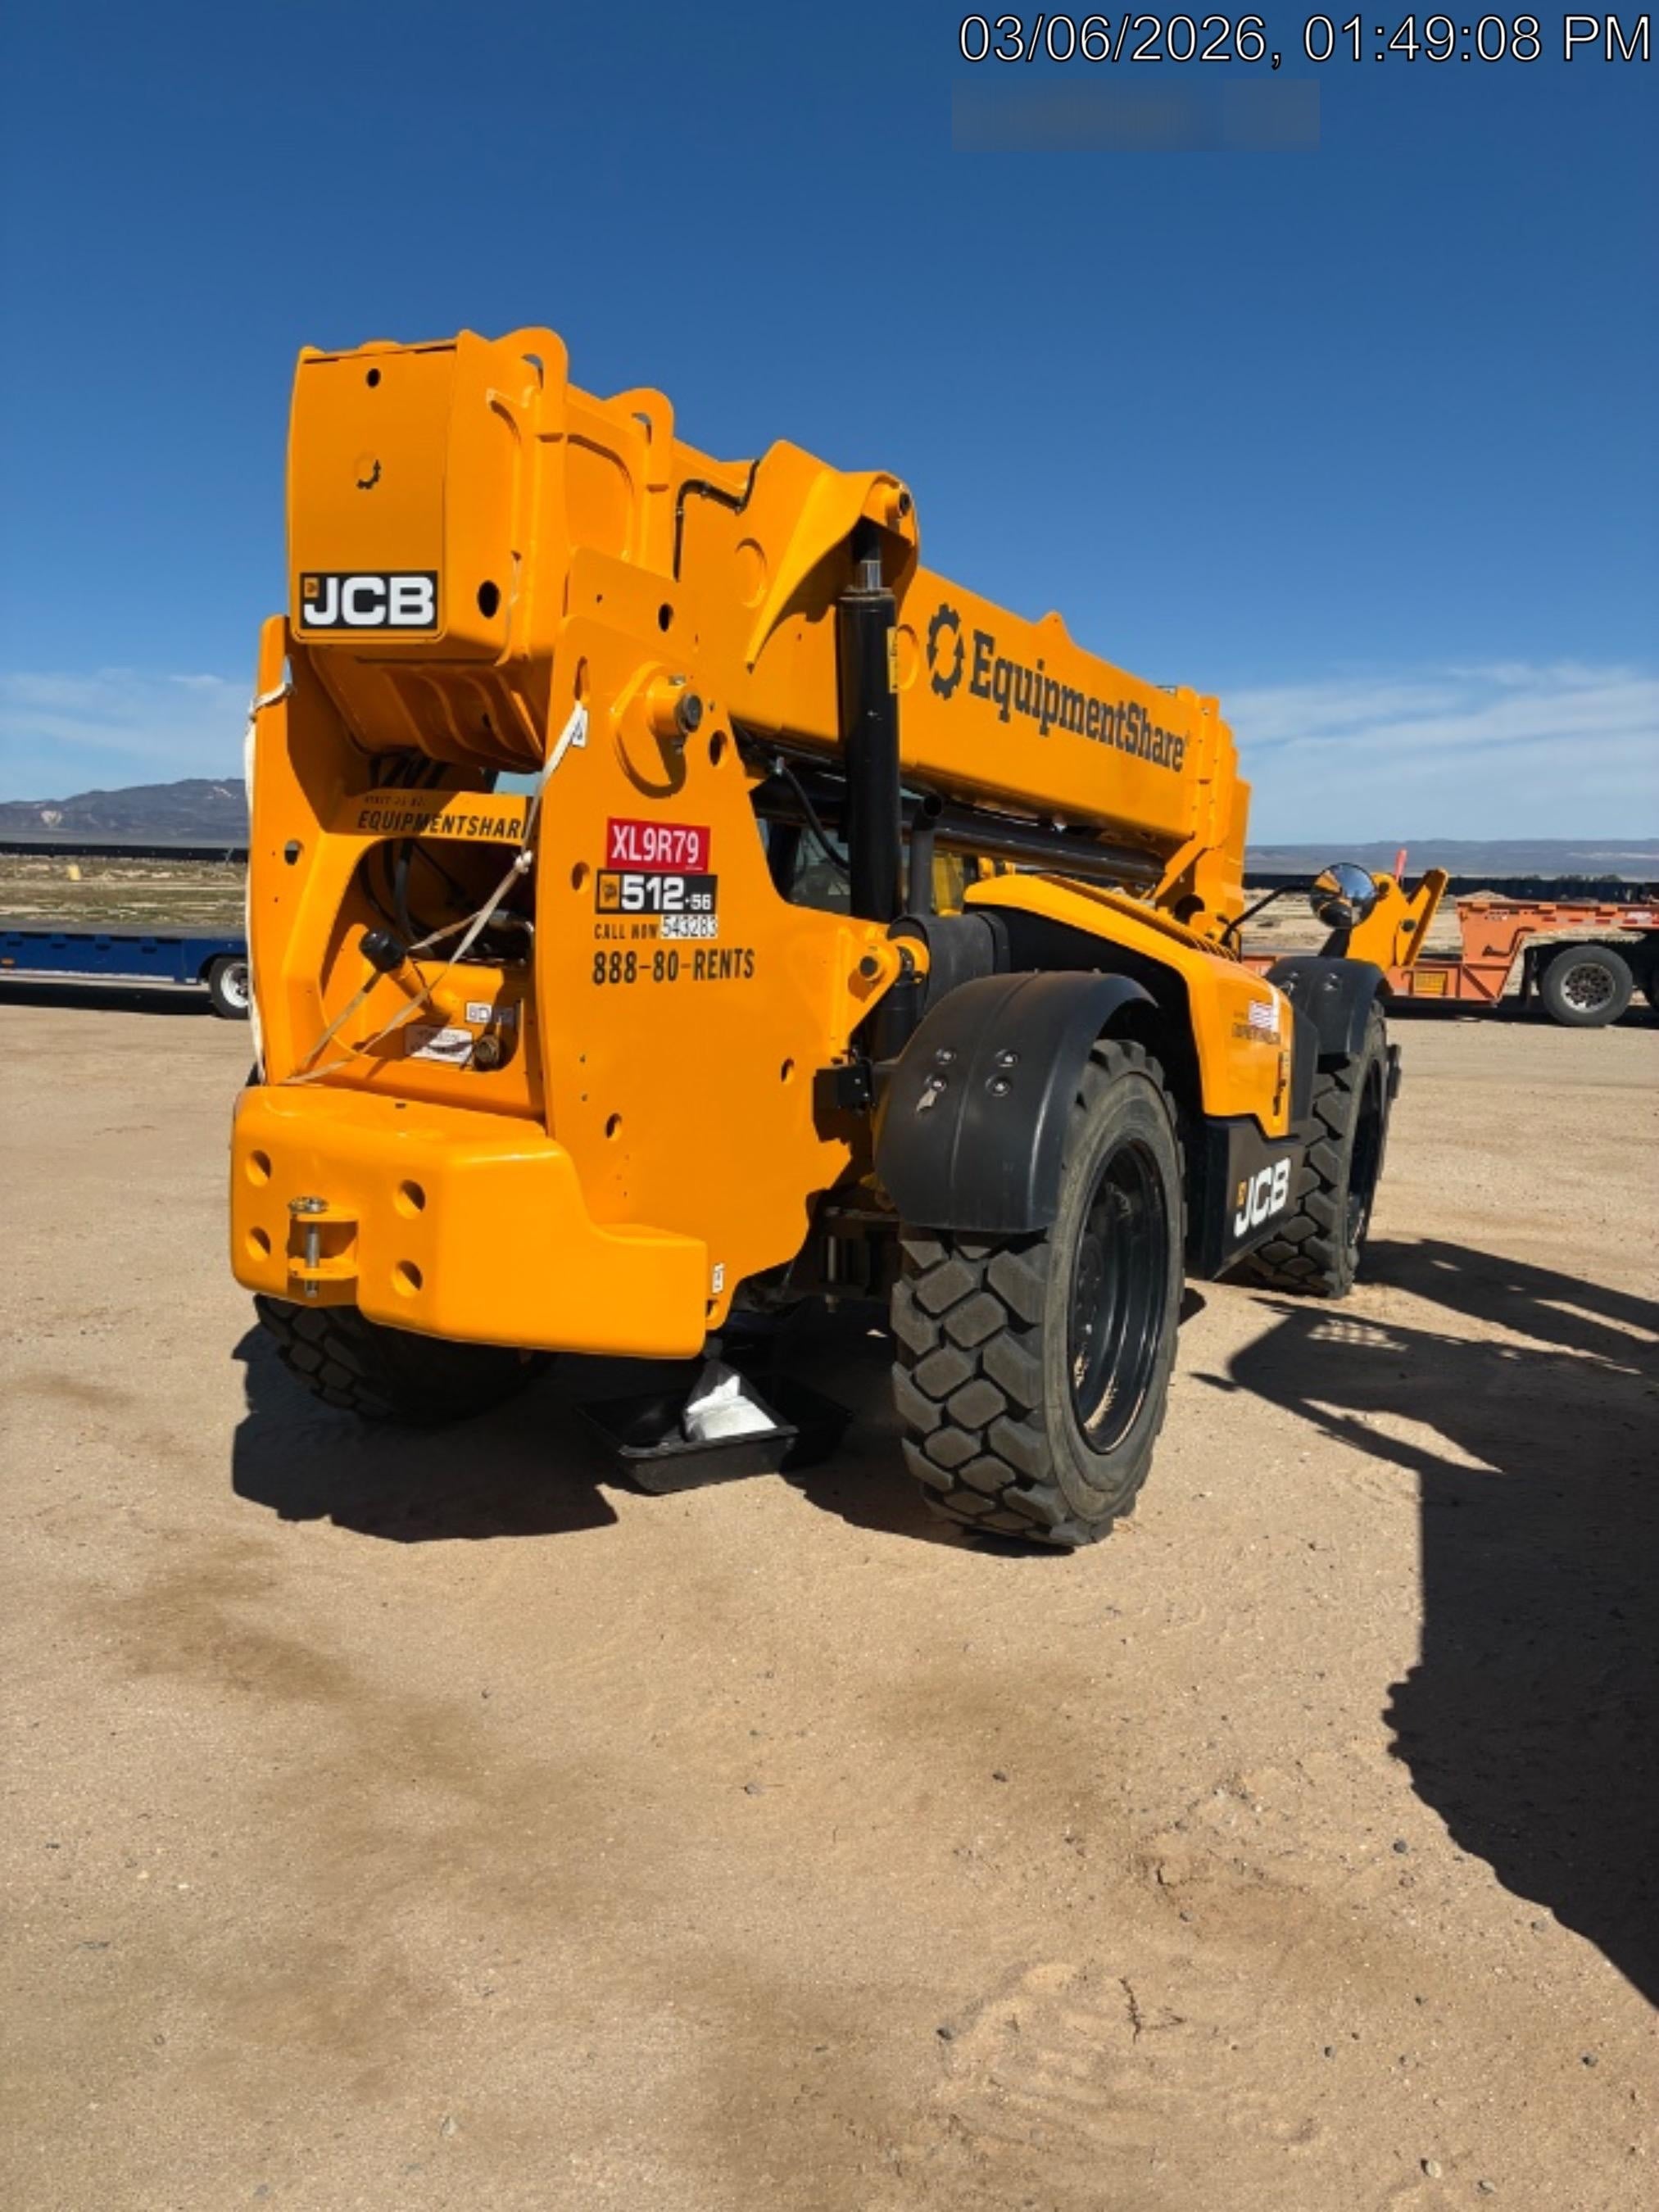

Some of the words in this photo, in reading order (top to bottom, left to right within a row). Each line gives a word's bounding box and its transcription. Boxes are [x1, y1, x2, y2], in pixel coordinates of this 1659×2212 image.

[303, 576, 435, 625] JCB
[969, 628, 1185, 773] EquipmentShare
[611, 825, 700, 864] XL9R79
[594, 923, 626, 940] CALL
[593, 948, 755, 986] 888-80-RENTS
[1234, 1157, 1292, 1238] JCB
